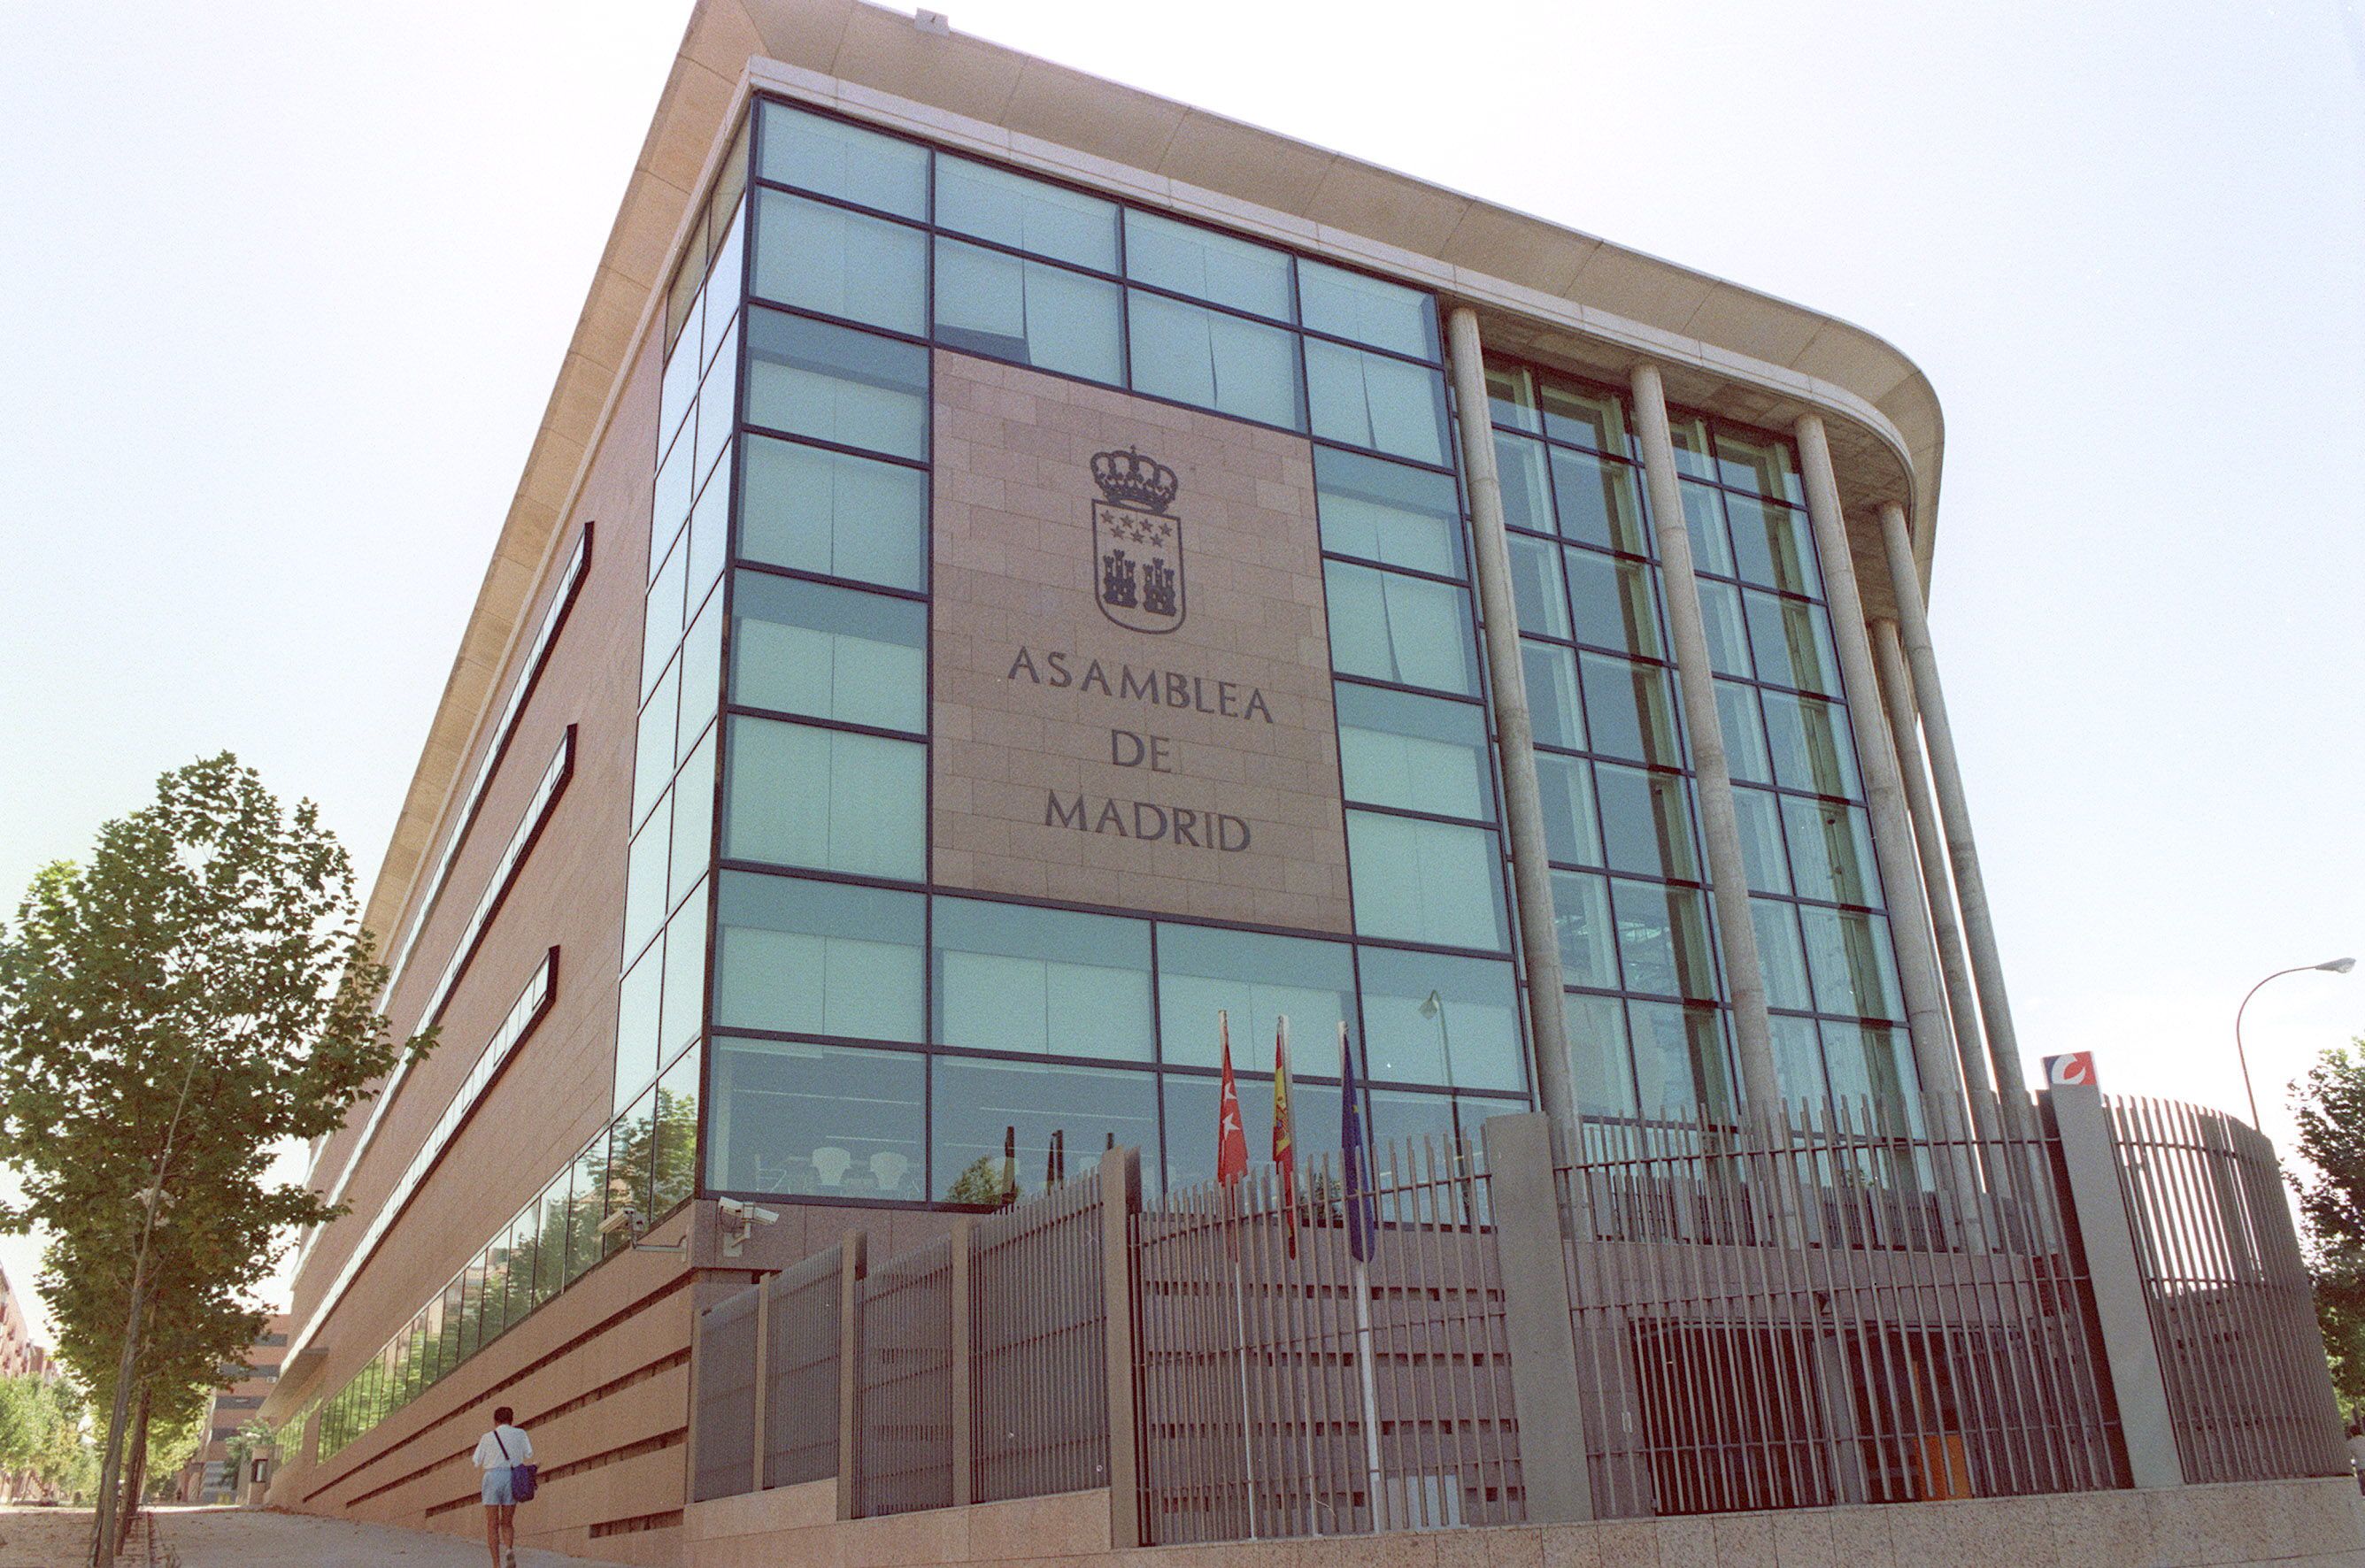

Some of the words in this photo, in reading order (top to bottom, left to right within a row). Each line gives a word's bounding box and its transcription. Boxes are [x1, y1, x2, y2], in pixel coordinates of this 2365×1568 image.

[1007, 646, 1273, 723] ASAMBLEA
[1112, 729, 1172, 772] DE
[1044, 788, 1252, 852] MADRID
